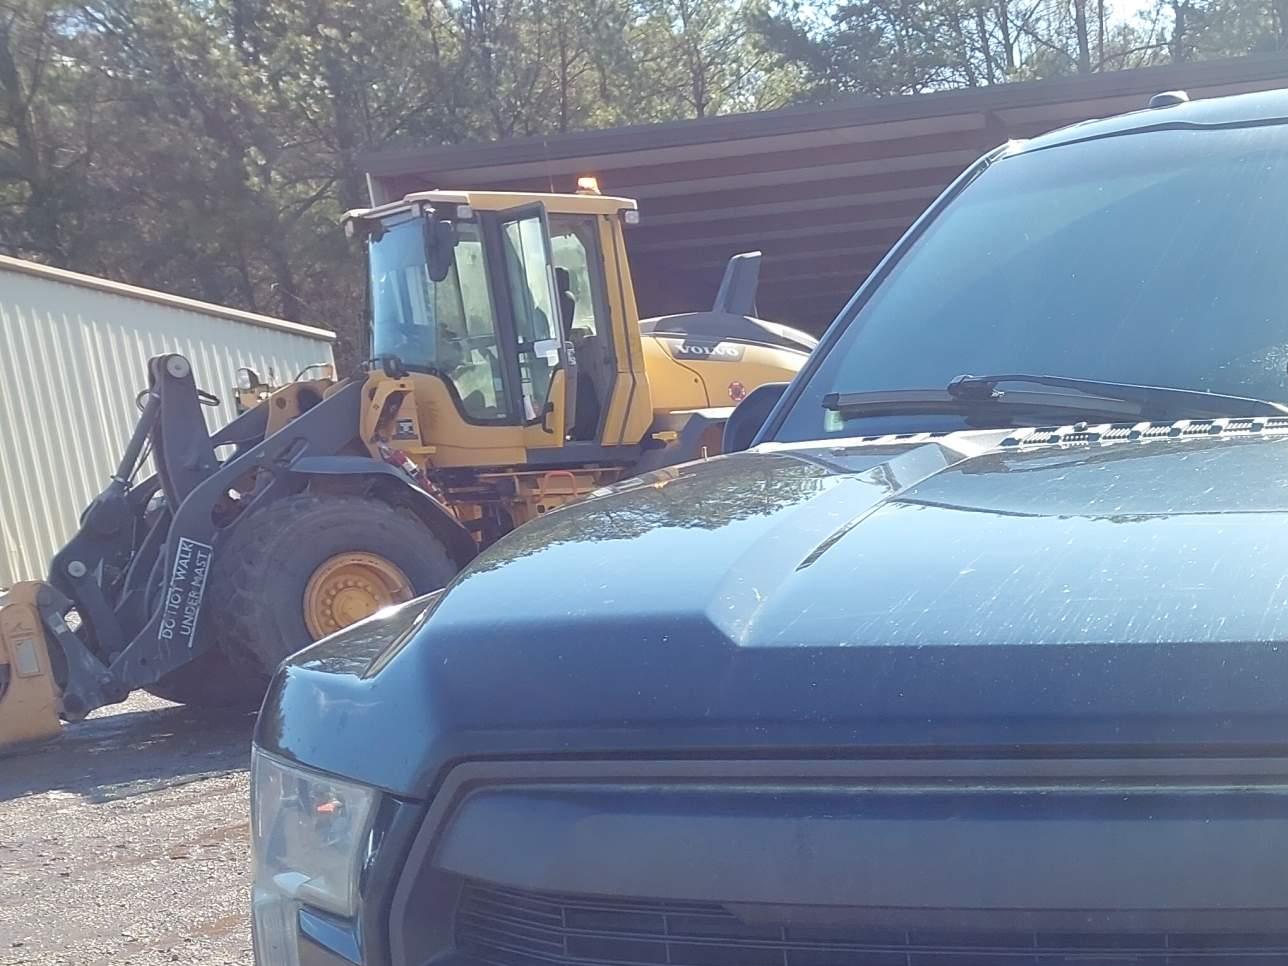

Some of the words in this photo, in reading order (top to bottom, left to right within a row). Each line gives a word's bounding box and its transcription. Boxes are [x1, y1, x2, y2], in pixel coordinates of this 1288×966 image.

[677, 345, 739, 357] VOLVO
[175, 543, 193, 580] WALK
[181, 590, 200, 635] UNDER
[194, 550, 209, 587] MAST
